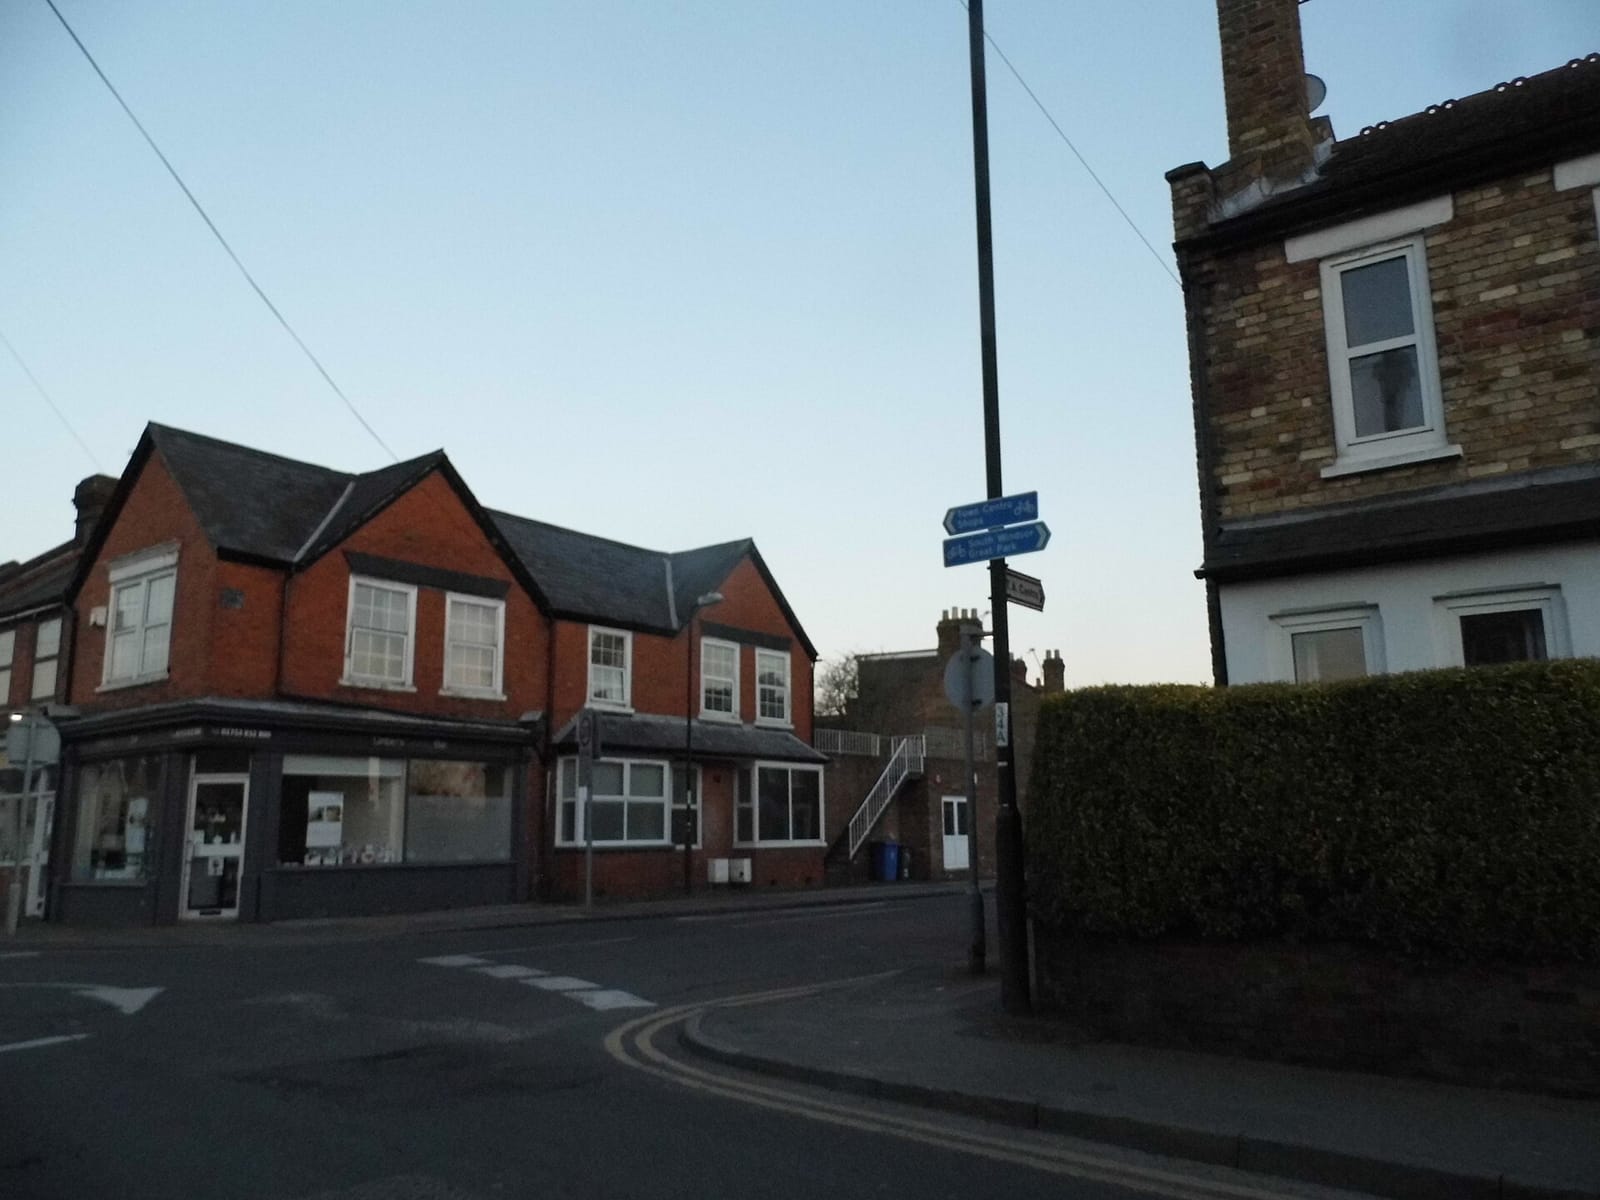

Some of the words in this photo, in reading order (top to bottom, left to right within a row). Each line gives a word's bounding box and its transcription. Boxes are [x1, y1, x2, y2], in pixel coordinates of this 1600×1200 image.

[983, 502, 1013, 512] Centre
[968, 546, 993, 559] Great
[997, 543, 1017, 553] Park
